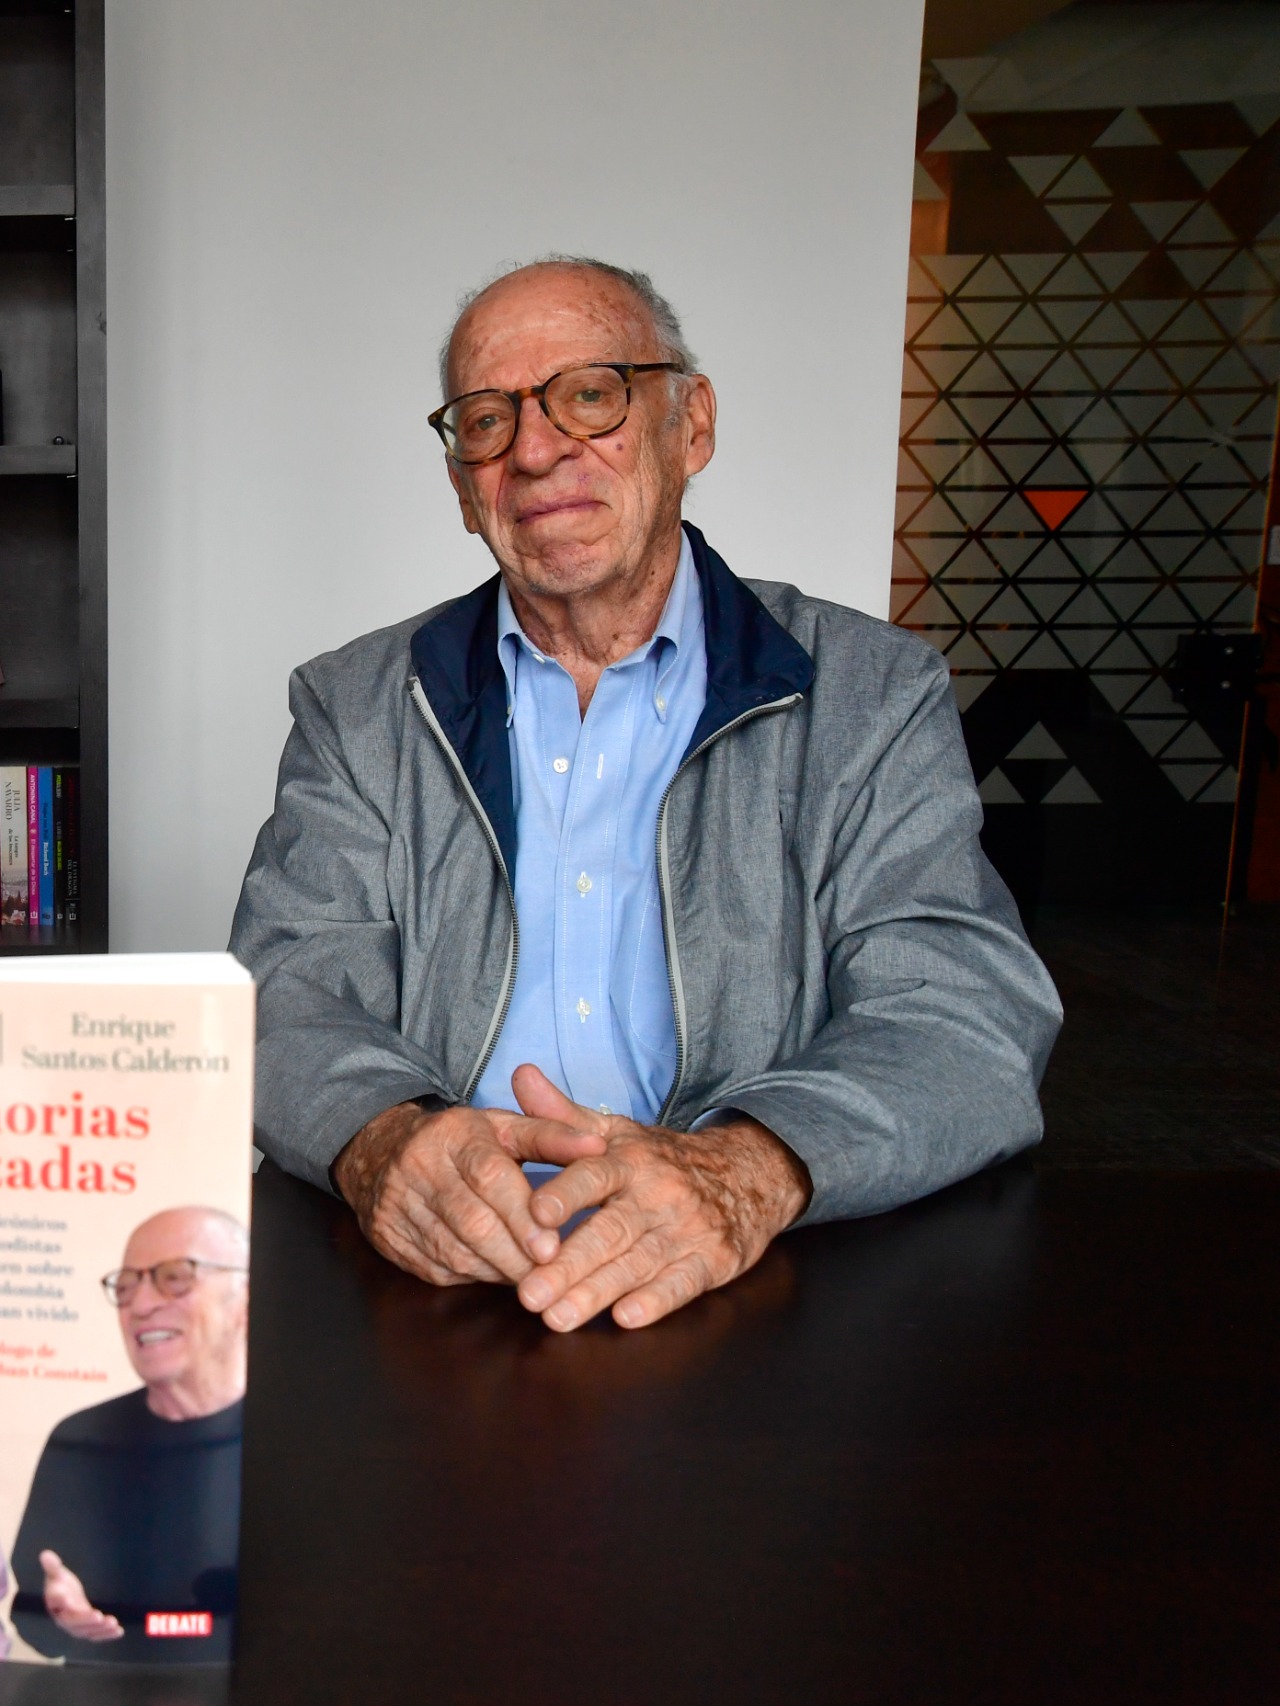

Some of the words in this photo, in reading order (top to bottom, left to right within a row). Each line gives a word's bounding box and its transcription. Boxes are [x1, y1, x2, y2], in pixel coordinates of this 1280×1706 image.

[4, 781, 13, 820] NAVARRO
[13, 789, 21, 812] JULIA
[71, 1013, 176, 1044] Enrique
[21, 1044, 108, 1072] Santos
[109, 1046, 230, 1075] Calderón
[26, 1260, 75, 1276] sobre
[26, 1305, 79, 1321] vivido
[37, 1343, 56, 1357] de
[147, 1614, 210, 1634] DEBATE
